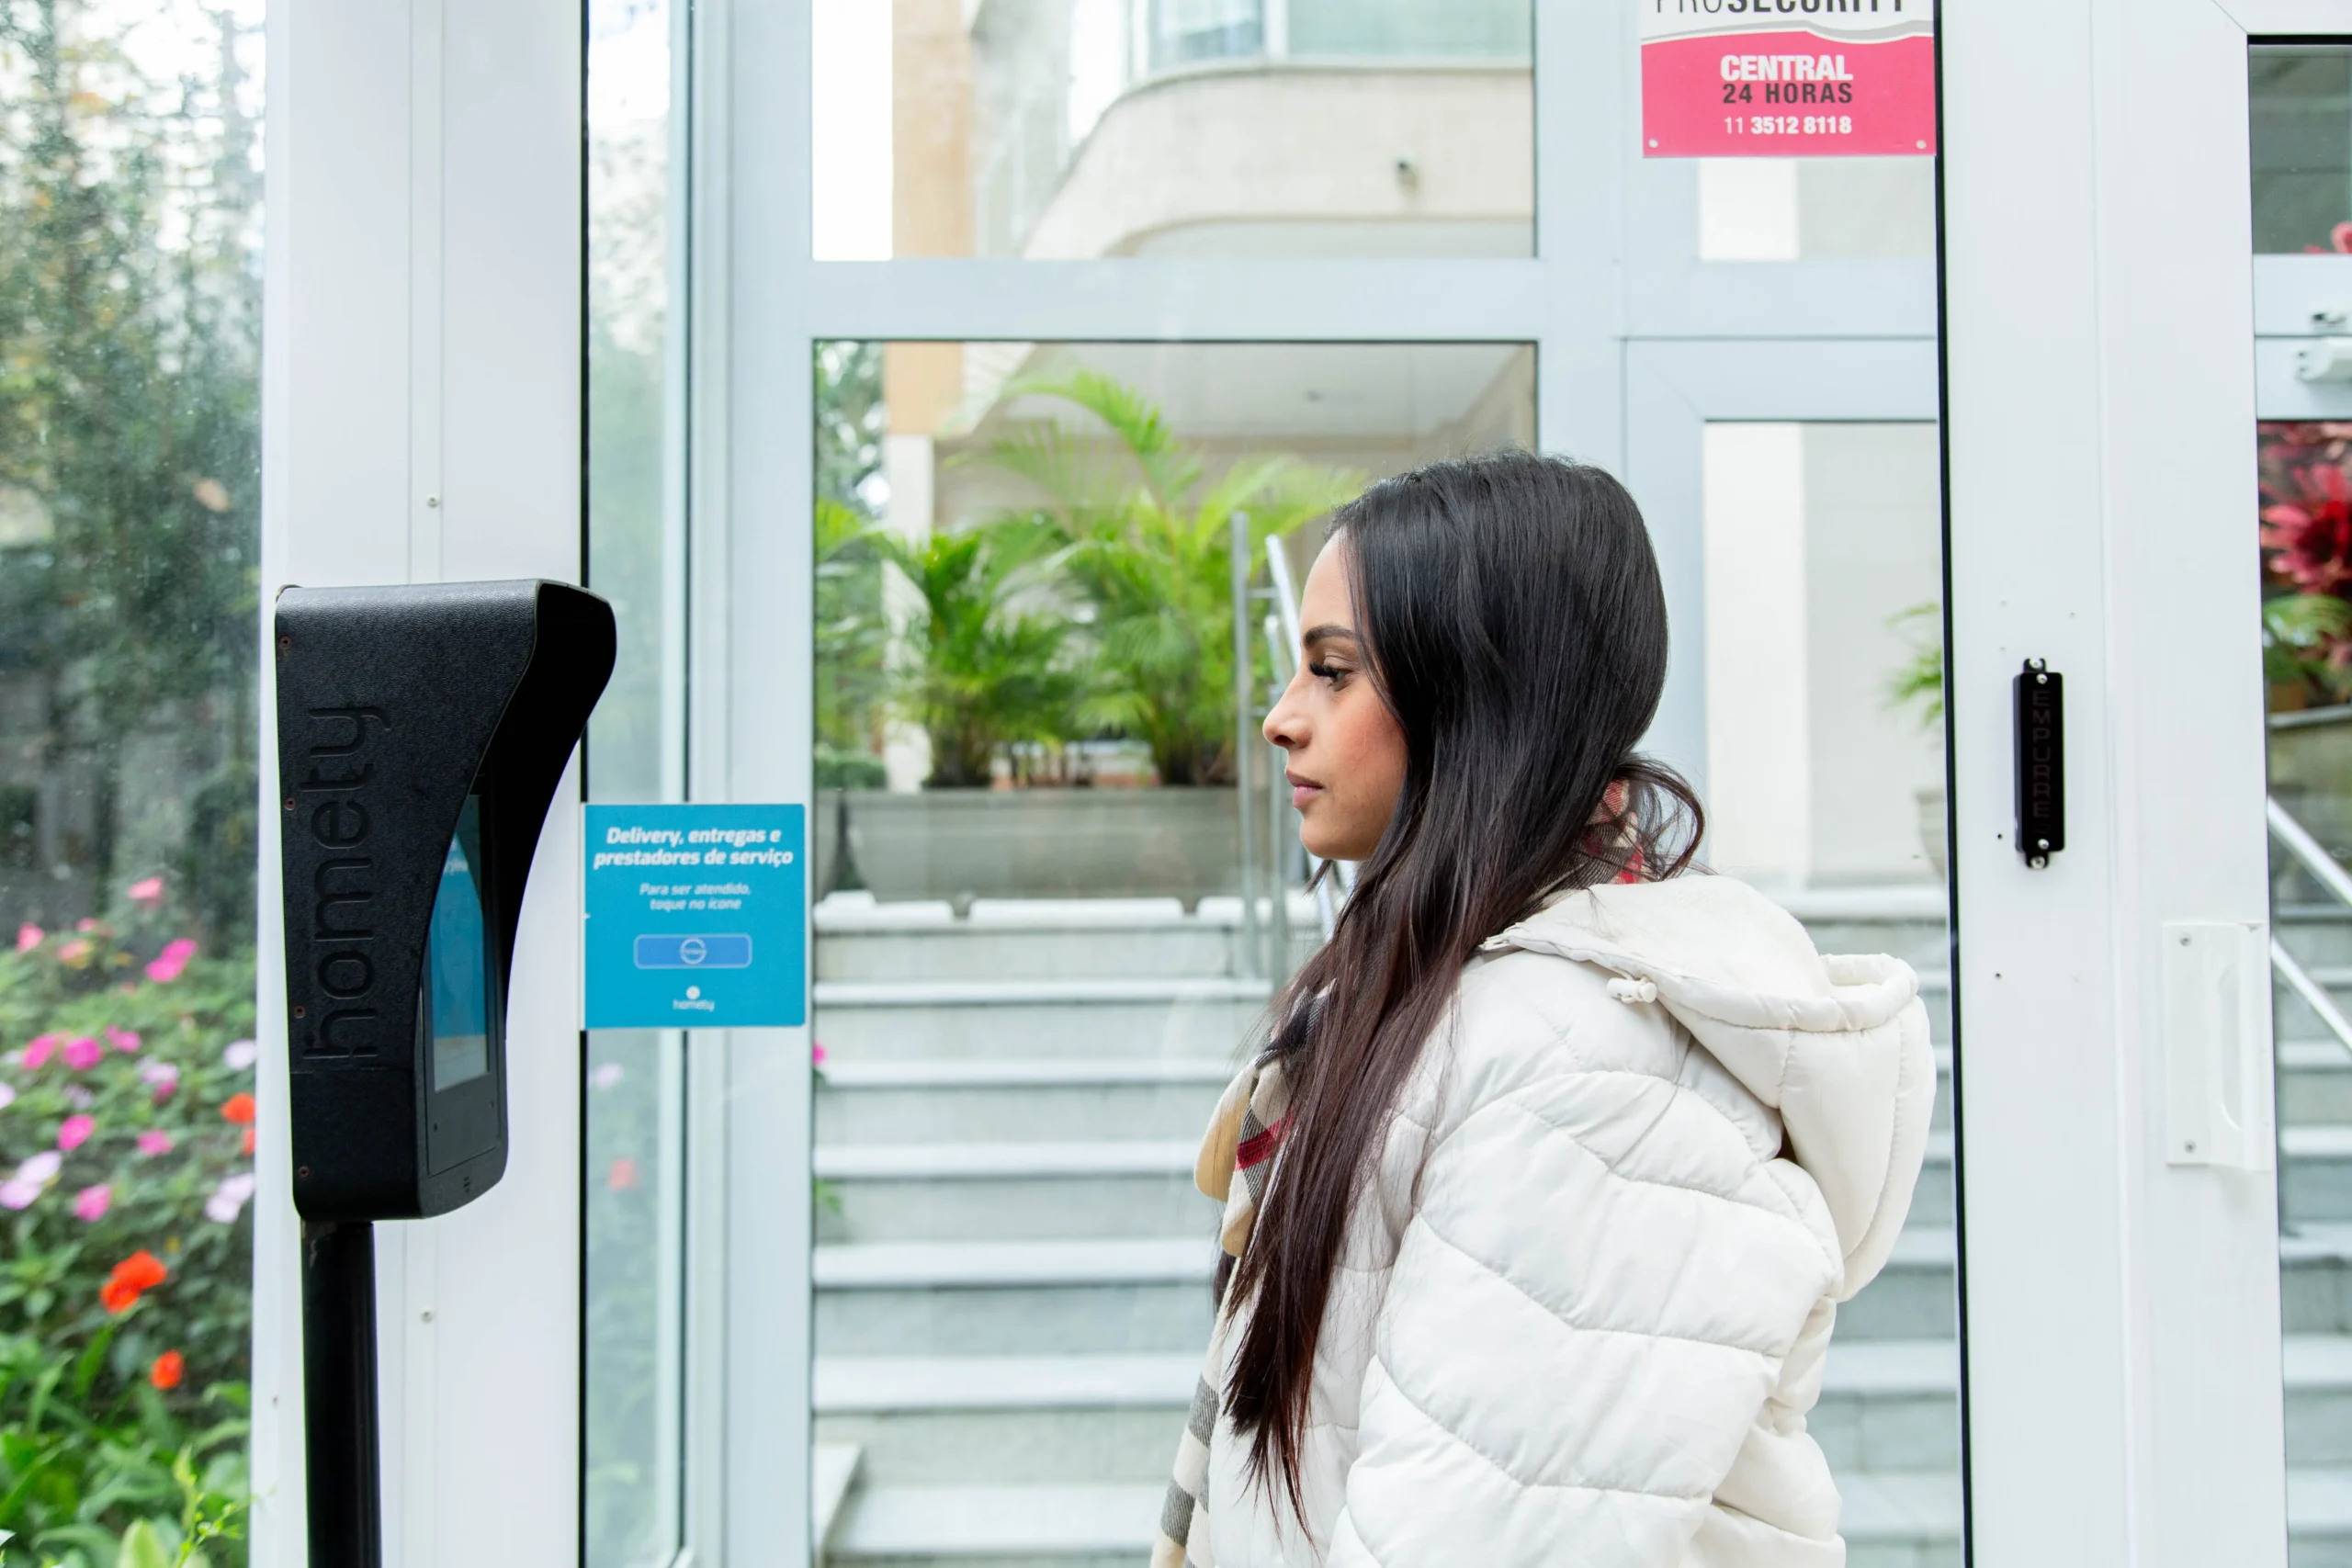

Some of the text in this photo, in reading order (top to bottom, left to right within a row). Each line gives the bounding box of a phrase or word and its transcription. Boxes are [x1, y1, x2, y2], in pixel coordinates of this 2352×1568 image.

[1720, 54, 1854, 81] CENTRAL
[1723, 83, 1853, 104] 24 HORAS
[1724, 116, 1853, 134] 11 3512 8118
[606, 827, 782, 848] Delivery, entregas e
[593, 848, 794, 871] prestadores de serviço
[300, 706, 391, 1060] homety
[639, 883, 669, 896] Para
[671, 885, 692, 896] ser
[650, 898, 687, 912] toque
[688, 899, 706, 909] no
